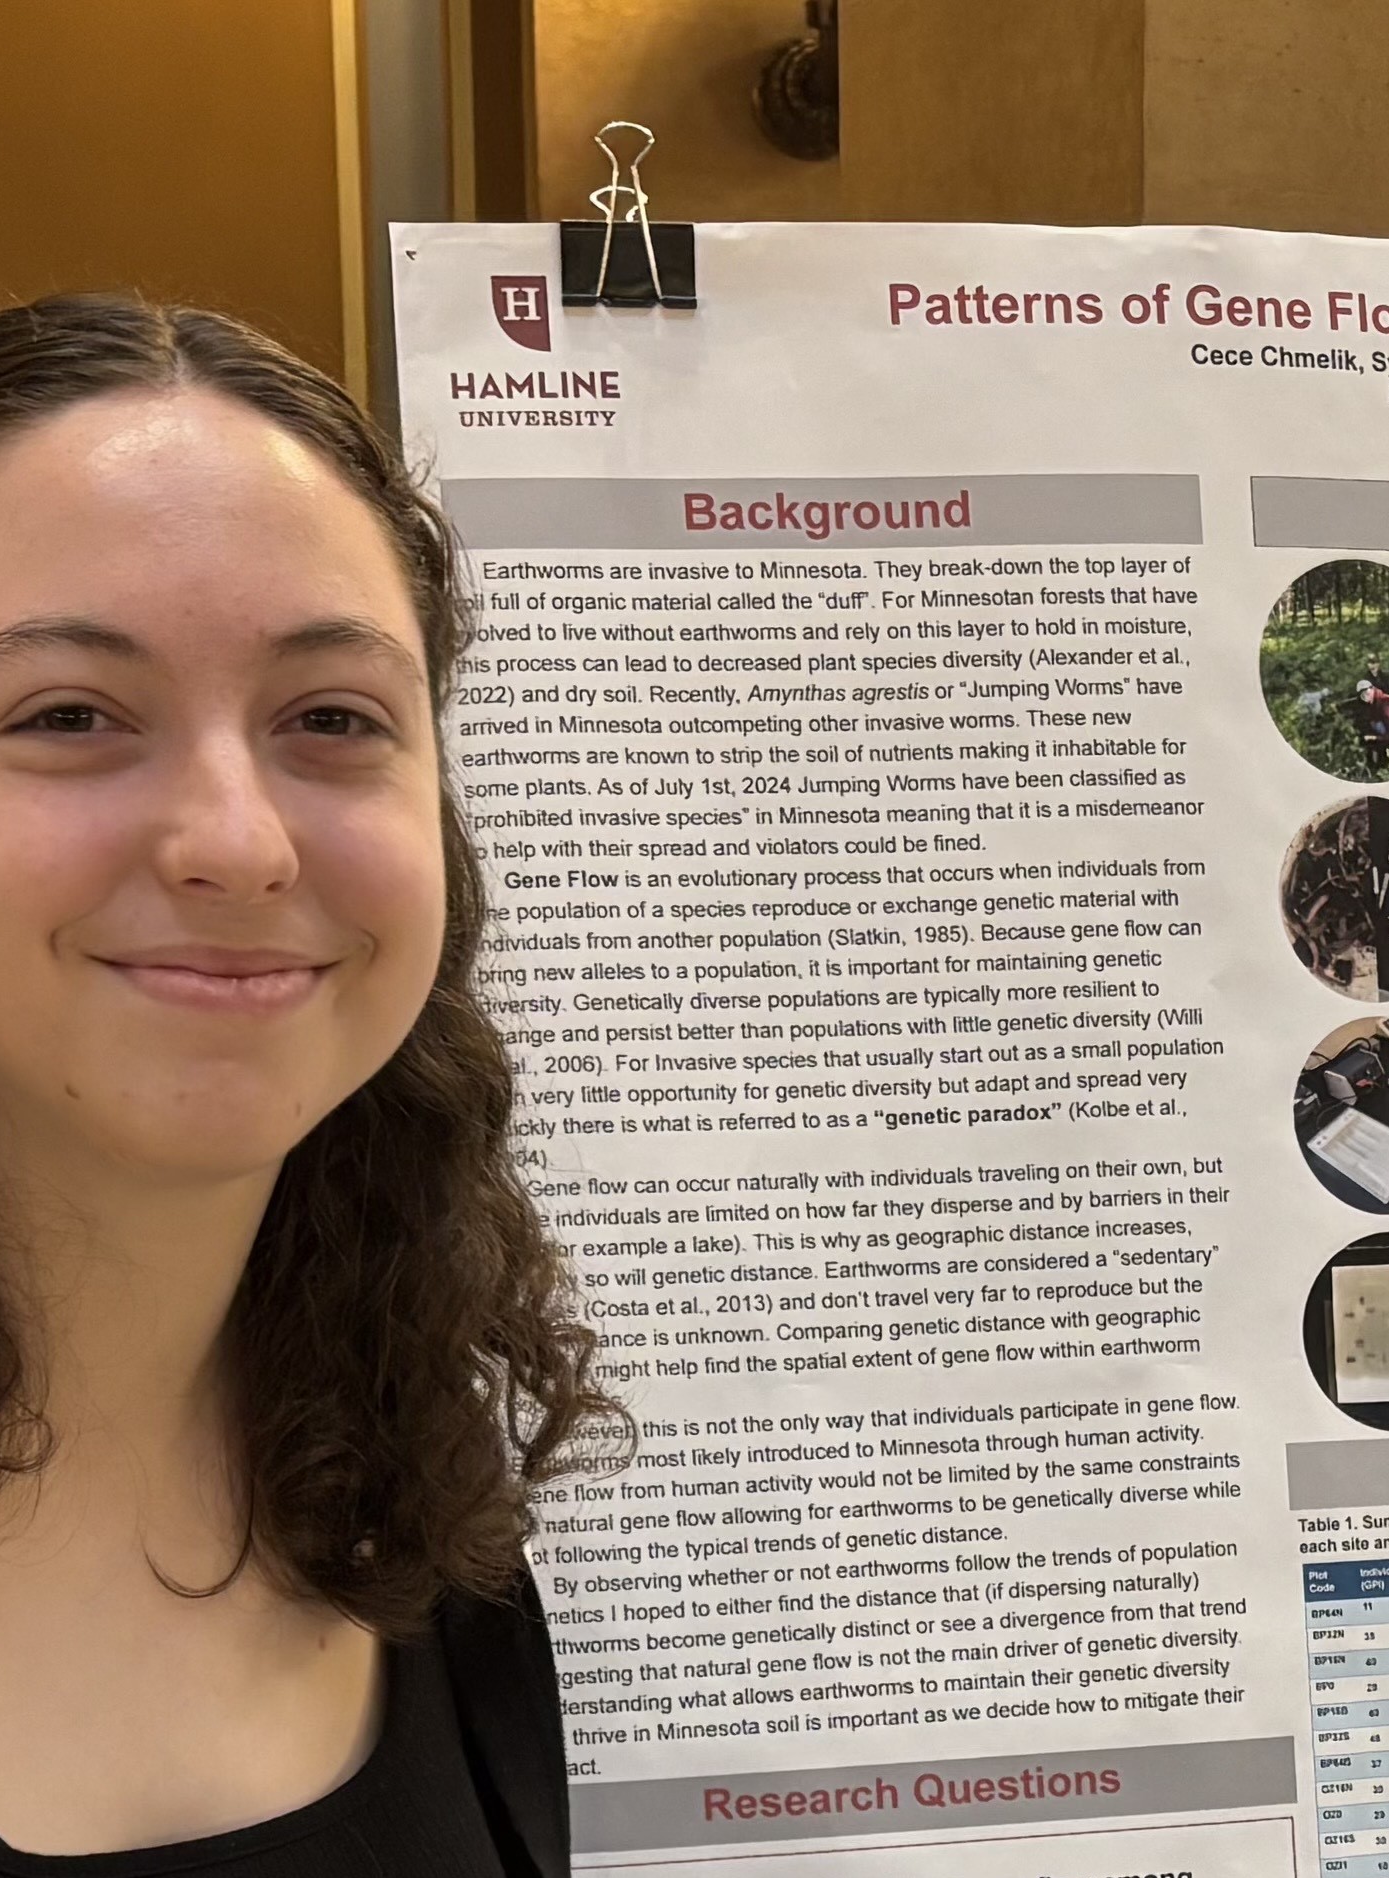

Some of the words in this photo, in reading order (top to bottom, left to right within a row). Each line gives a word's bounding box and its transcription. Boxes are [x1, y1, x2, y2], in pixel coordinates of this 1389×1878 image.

[499, 286, 542, 323] H
[888, 283, 1104, 326] Patterns
[1121, 282, 1171, 325] of
[1185, 284, 1312, 330] Gene
[1190, 343, 1254, 366] Cece
[1260, 345, 1365, 375] Chmelik,
[450, 370, 621, 400] HAMLINE
[458, 409, 617, 428] UNIVERSITY
[683, 489, 971, 541] Background
[482, 561, 605, 580] Earthworms
[609, 565, 643, 580] are
[648, 561, 730, 580] invasive
[734, 562, 754, 580] to
[760, 560, 868, 580] Minnesota.
[873, 560, 923, 583] They
[928, 557, 1043, 577] break-down
[1048, 556, 1080, 575] the
[1084, 557, 1116, 578] top
[1120, 556, 1168, 578] layer
[1172, 555, 1192, 574] of
[503, 871, 561, 890] Gene
[567, 869, 619, 888] Flow
[624, 869, 642, 888] is
[647, 873, 672, 888] an
[677, 868, 798, 890] evolutionary
[803, 870, 882, 890] process
[886, 865, 925, 884] that
[929, 867, 995, 883] occurs
[998, 862, 1052, 880] when
[1057, 858, 1158, 879] individuals
[1163, 858, 1206, 876] from
[1297, 1516, 1341, 1533] Table
[1344, 1515, 1358, 1530] 1.
[1299, 1538, 1338, 1554] each
[1341, 1536, 1370, 1552] site
[704, 1776, 899, 1820] Research
[913, 1766, 1121, 1808] Questions
